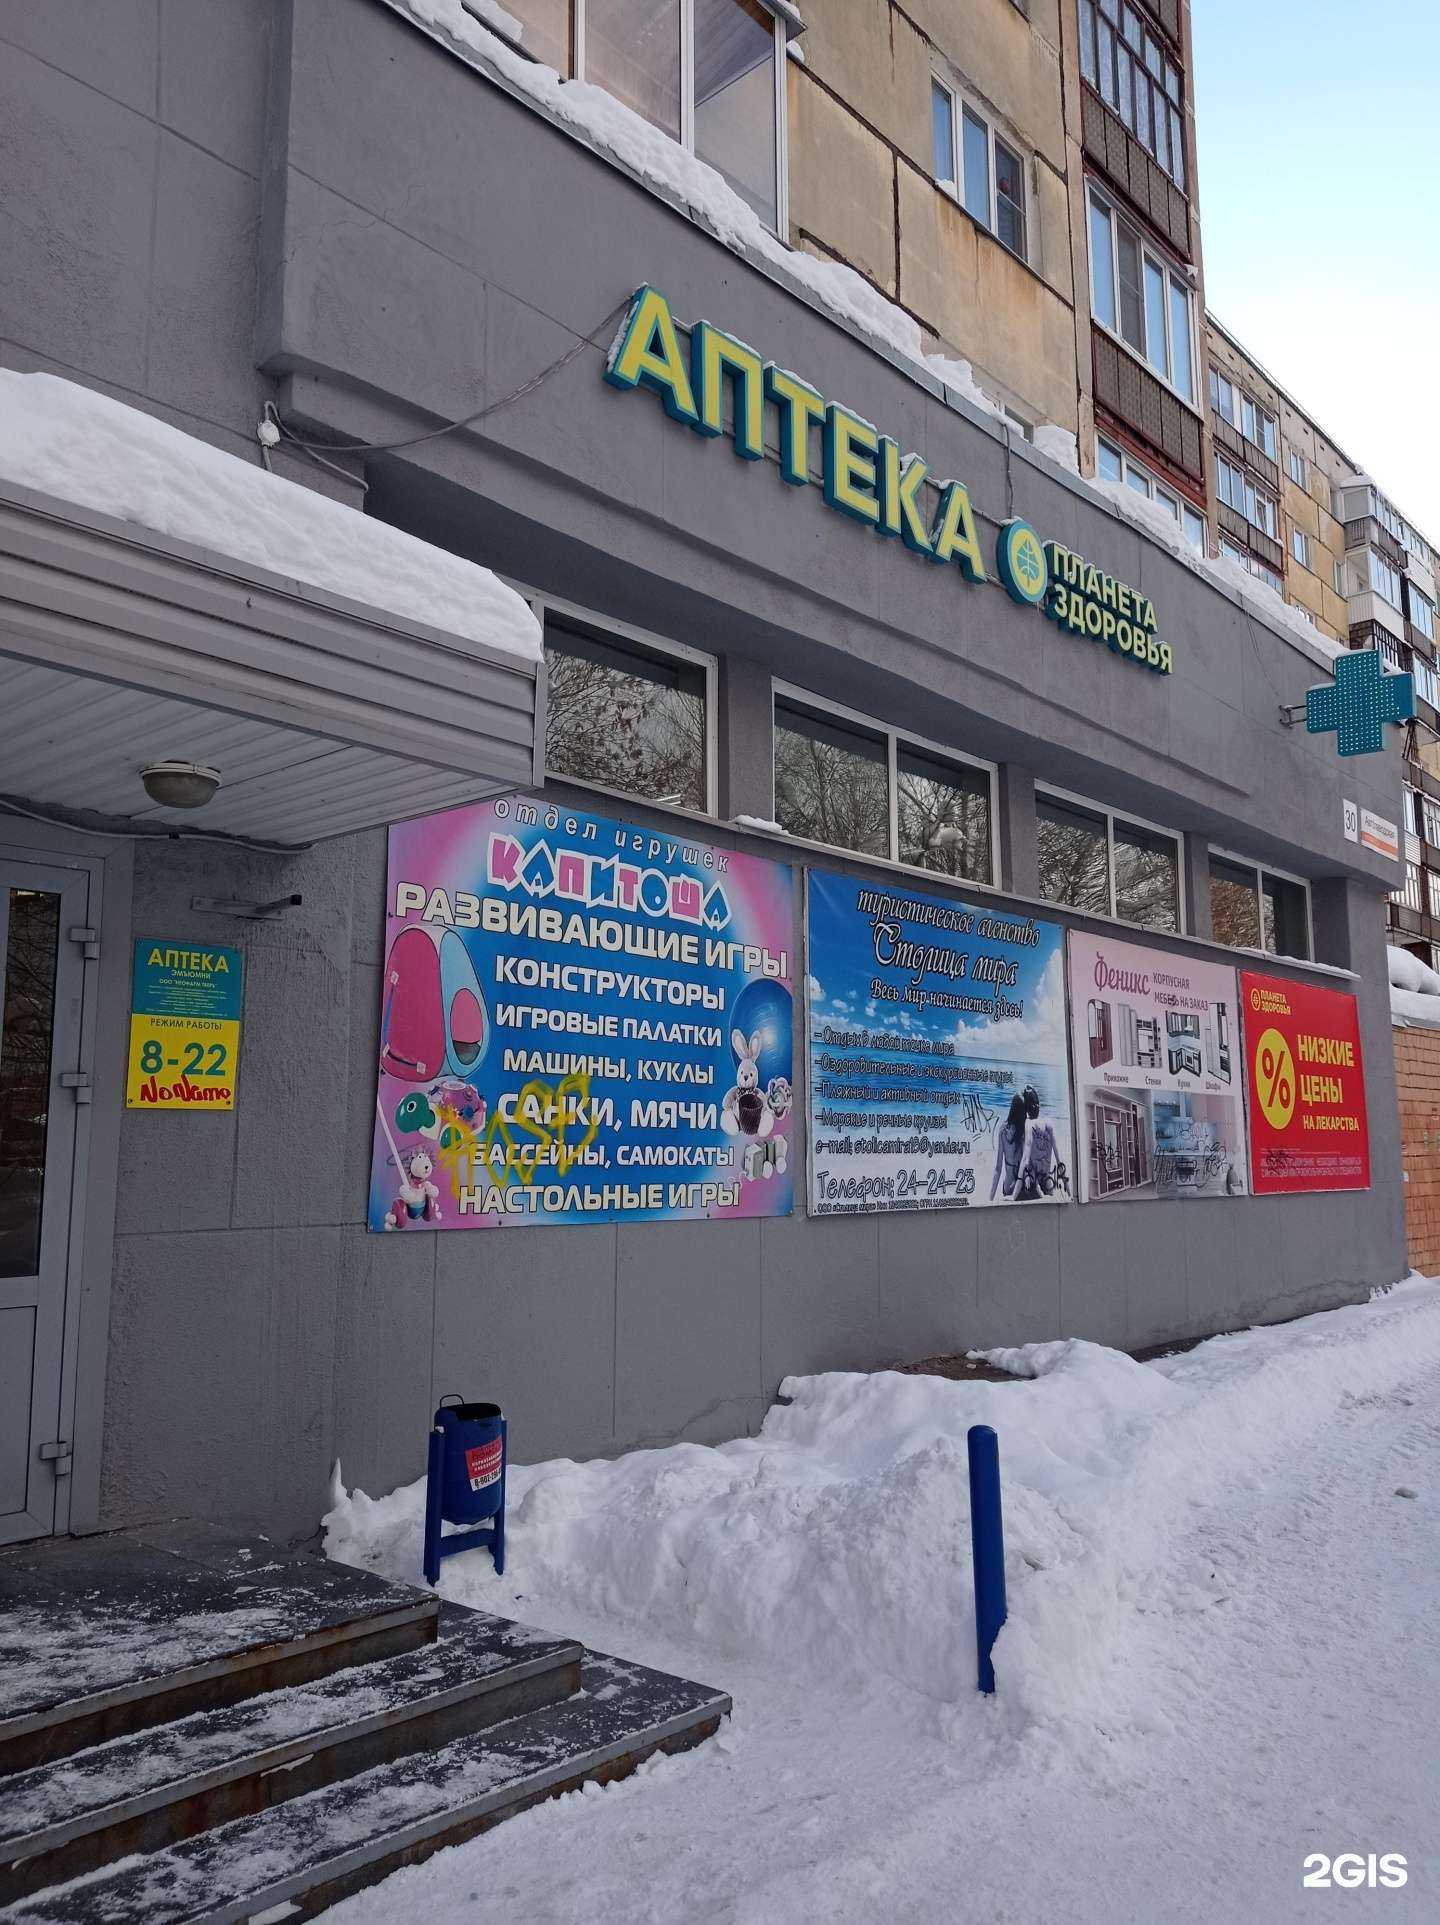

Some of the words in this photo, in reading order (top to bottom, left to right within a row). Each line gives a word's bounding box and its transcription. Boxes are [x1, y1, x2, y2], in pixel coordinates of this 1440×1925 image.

[603, 284, 988, 583] АПТЕКА
[1050, 542, 1159, 633] ПЛАНЕТА
[1051, 582, 1174, 676] ЗДОРОВЬЯ
[494, 799, 598, 841] отдел
[614, 831, 730, 873] игрушек
[1345, 809, 1356, 832] 30
[488, 833, 732, 931] КАПИТОША
[857, 889, 975, 933] туристическое
[396, 882, 699, 965] РАЗВИВАЮЩИЕ
[705, 938, 788, 978] ИГРЫ
[148, 948, 229, 973] АПТЕКА
[873, 922, 968, 985] Столица
[972, 955, 1019, 997] мира
[1094, 952, 1151, 995] Феникс
[495, 955, 725, 1010] КОНСТРУКТОРЫ
[1153, 972, 1190, 990] КОРПУСНАЯ
[1260, 989, 1287, 1004] ПЛАНЕТА
[871, 978, 900, 999] Весь
[994, 996, 1024, 1022] здесь!
[1180, 996, 1189, 1009] НА
[1190, 998, 1209, 1011] ЗАКАЗ
[1261, 1001, 1291, 1016] ЗДОРОВЬЯ
[150, 1018, 184, 1029] РЕЖИМ
[186, 1020, 222, 1031] РАБОТЫ
[496, 1003, 619, 1038] ИГРОВЫЕ
[623, 1018, 722, 1047] ПАЛАТКИ
[140, 1040, 227, 1076] 8-22
[503, 1048, 631, 1082] МАШИНЫ,
[637, 1058, 715, 1085] КУКЛЫ
[1297, 1034, 1355, 1067] НИЗКИЕ
[1300, 1073, 1343, 1106] ЦЕНЫ
[497, 1092, 622, 1131] САНКИ,
[630, 1100, 718, 1130] МЯЧИ
[1303, 1115, 1315, 1130] НА
[1316, 1115, 1360, 1131] ЛЕКАРСТВА
[470, 1138, 611, 1170] БАССЕЙНЫ,
[615, 1143, 735, 1167] САМОКАТЫ
[458, 1182, 664, 1215] НАСТОЛЬНЫЕ
[668, 1182, 740, 1209] ИГРЫ
[817, 1170, 895, 1203] Телефон:
[897, 1168, 976, 1196] 24-24-23
